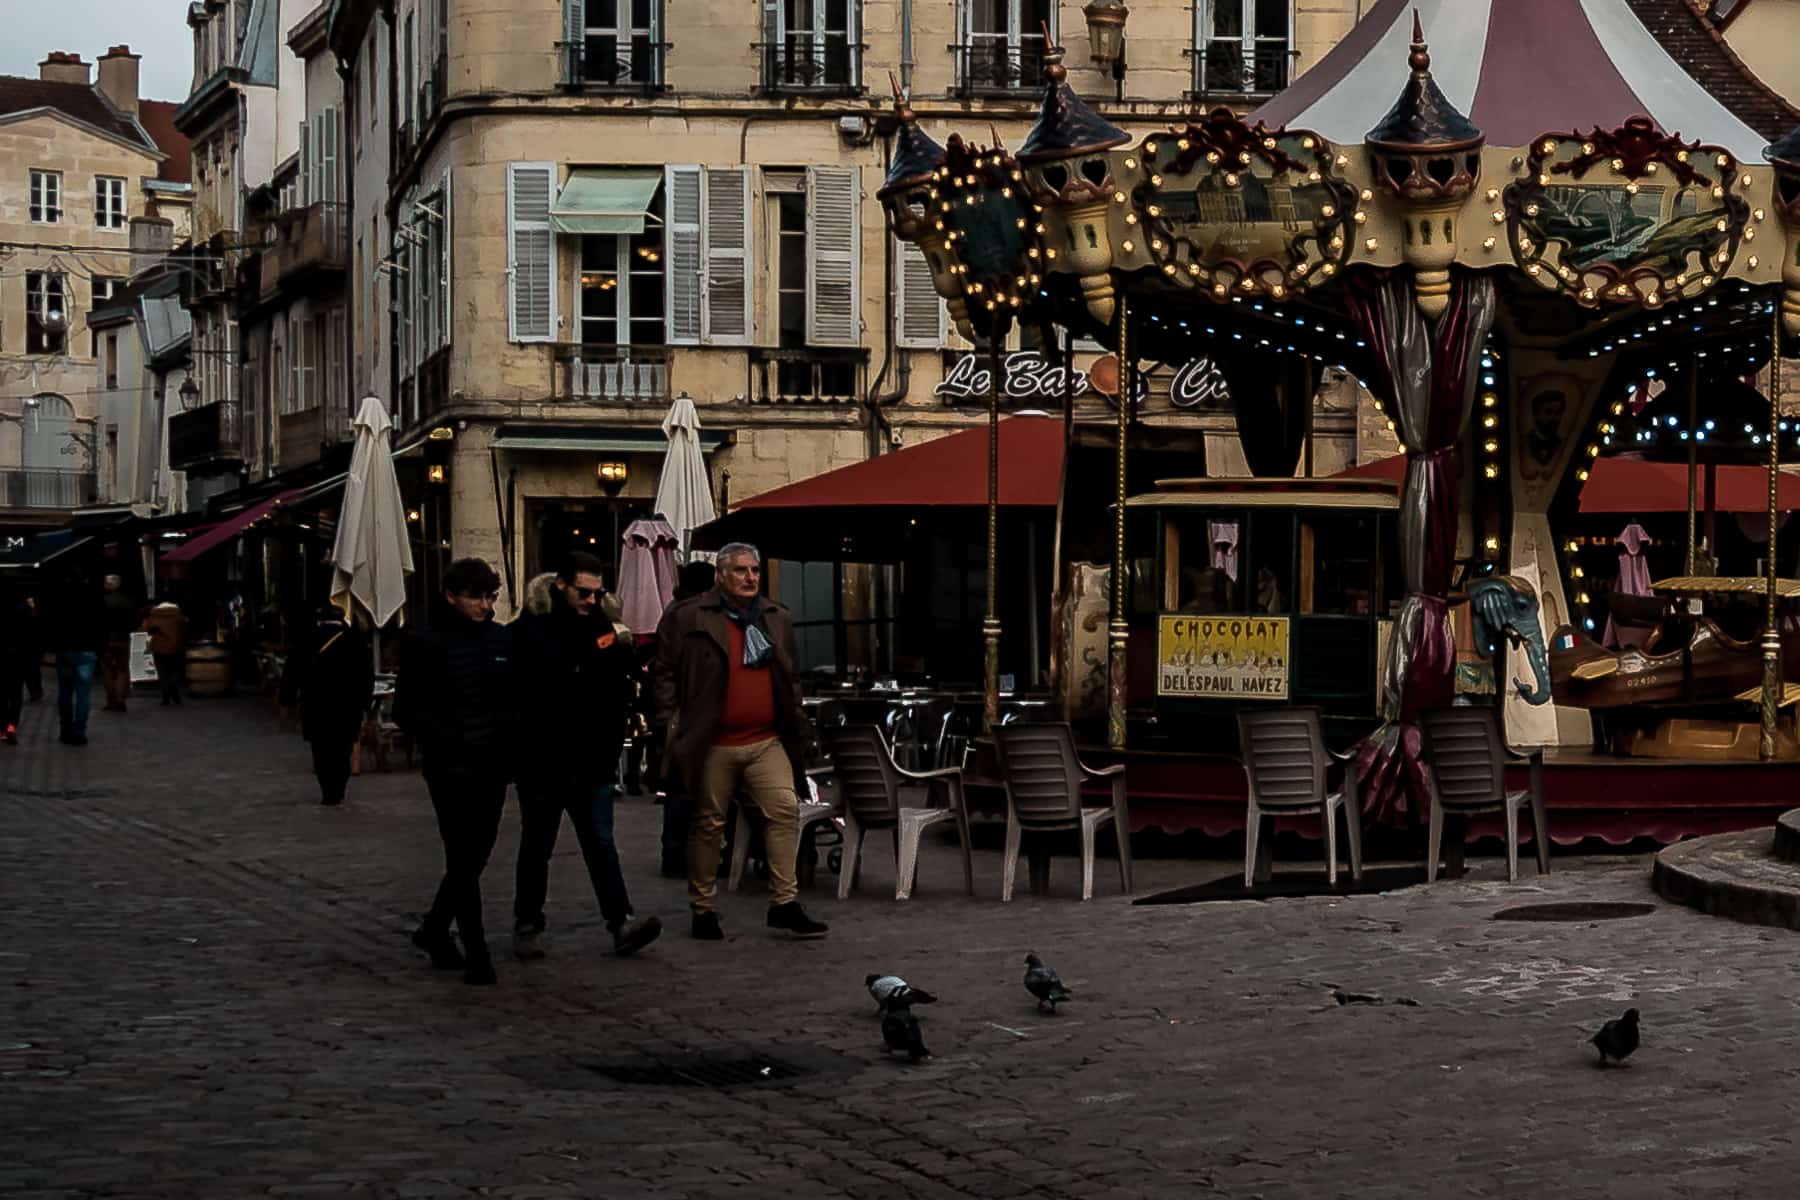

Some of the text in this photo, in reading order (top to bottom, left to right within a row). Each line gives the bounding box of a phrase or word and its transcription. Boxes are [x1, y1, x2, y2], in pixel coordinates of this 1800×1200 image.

[935, 353, 990, 396] Le
[1004, 351, 1089, 397] Bar
[1173, 620, 1279, 641] CHOCOLAT
[1164, 675, 1282, 693] DELESPAUL HAVEZ
